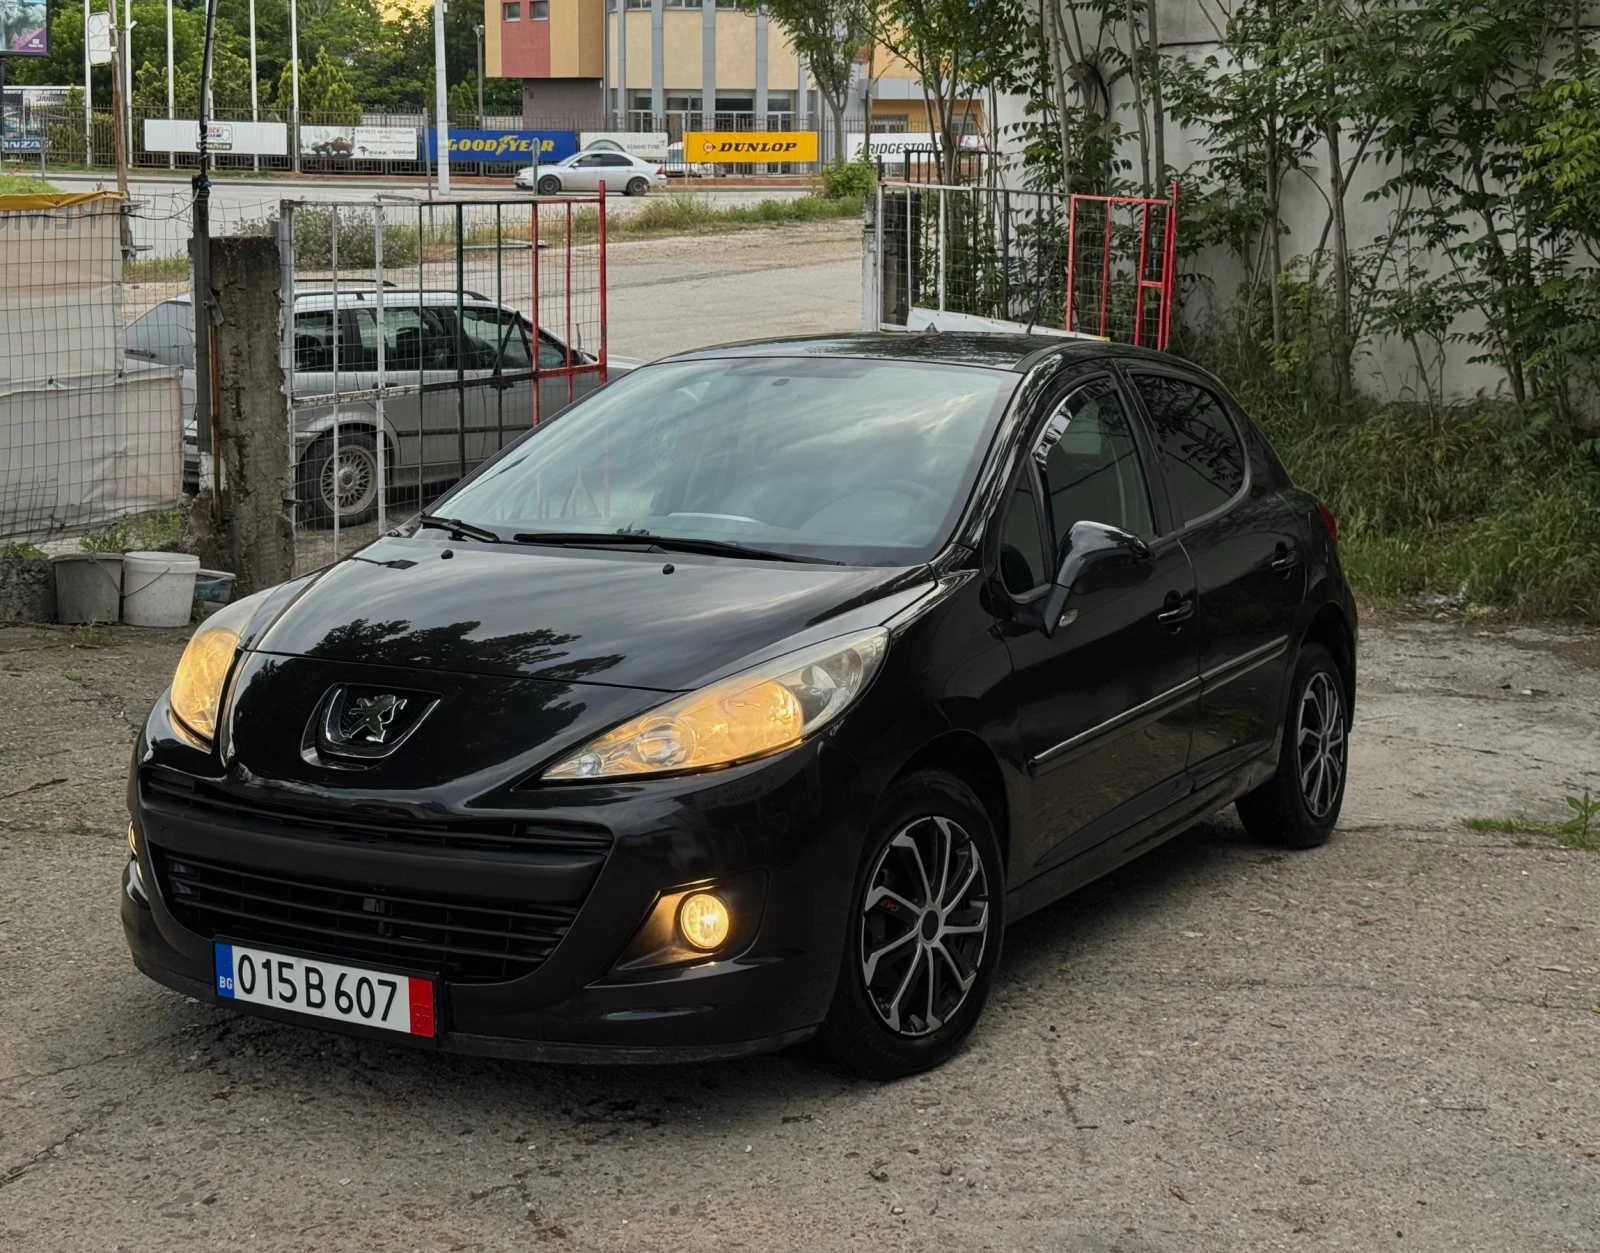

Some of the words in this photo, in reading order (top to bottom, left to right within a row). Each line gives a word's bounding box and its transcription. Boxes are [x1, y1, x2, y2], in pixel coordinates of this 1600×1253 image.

[718, 142, 797, 152] DUNLOP
[880, 900, 900, 912] EVO
[219, 975, 233, 991] BG
[413, 1012, 430, 1030] 27
